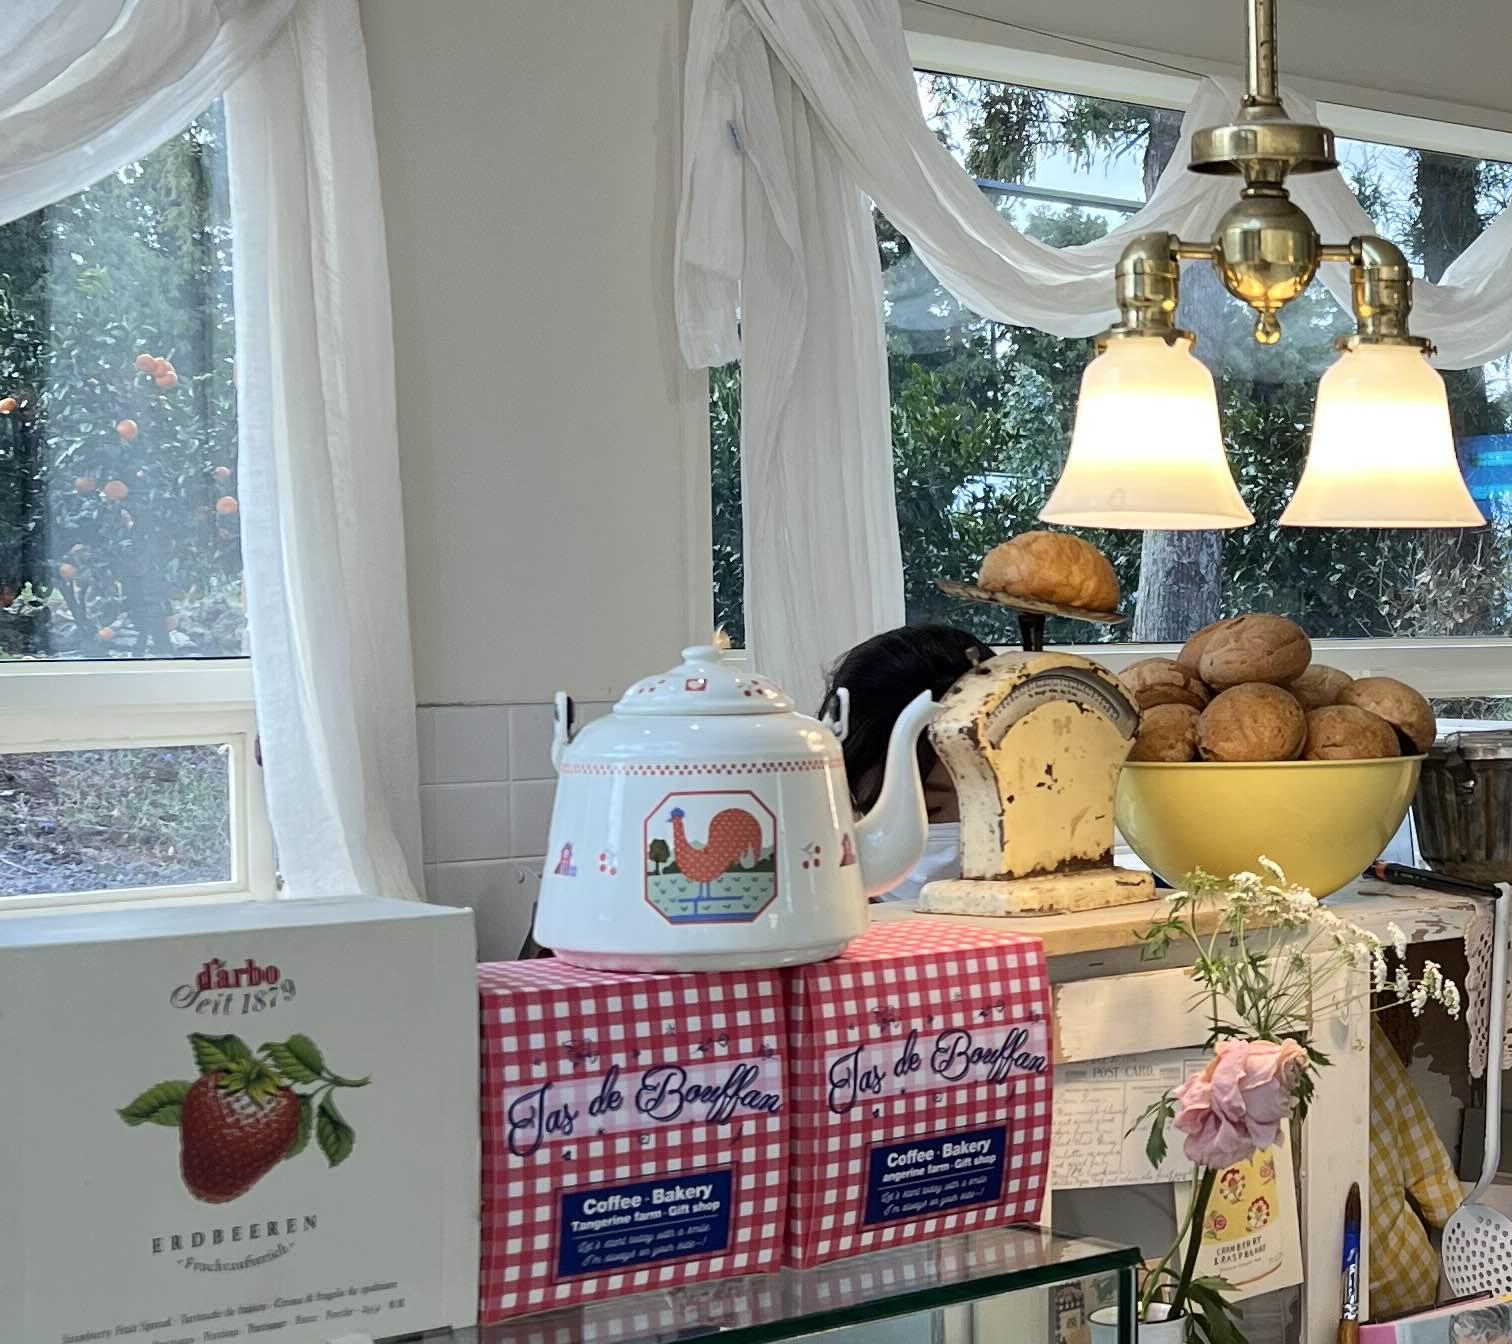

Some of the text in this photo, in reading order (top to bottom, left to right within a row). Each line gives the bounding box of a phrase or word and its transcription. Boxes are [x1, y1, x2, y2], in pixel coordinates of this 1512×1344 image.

[169, 978, 297, 1016] Seit 1879
[829, 1027, 1048, 1115] Jas de Bouffan
[507, 1063, 784, 1157] Jas de Bouffan
[887, 1138, 992, 1168] Coffee Bakery
[583, 1184, 714, 1215] Coffee Bakery
[668, 1205, 690, 1216] Gift
[692, 1201, 721, 1213] shop
[151, 1214, 318, 1254] ERDBEEREN
